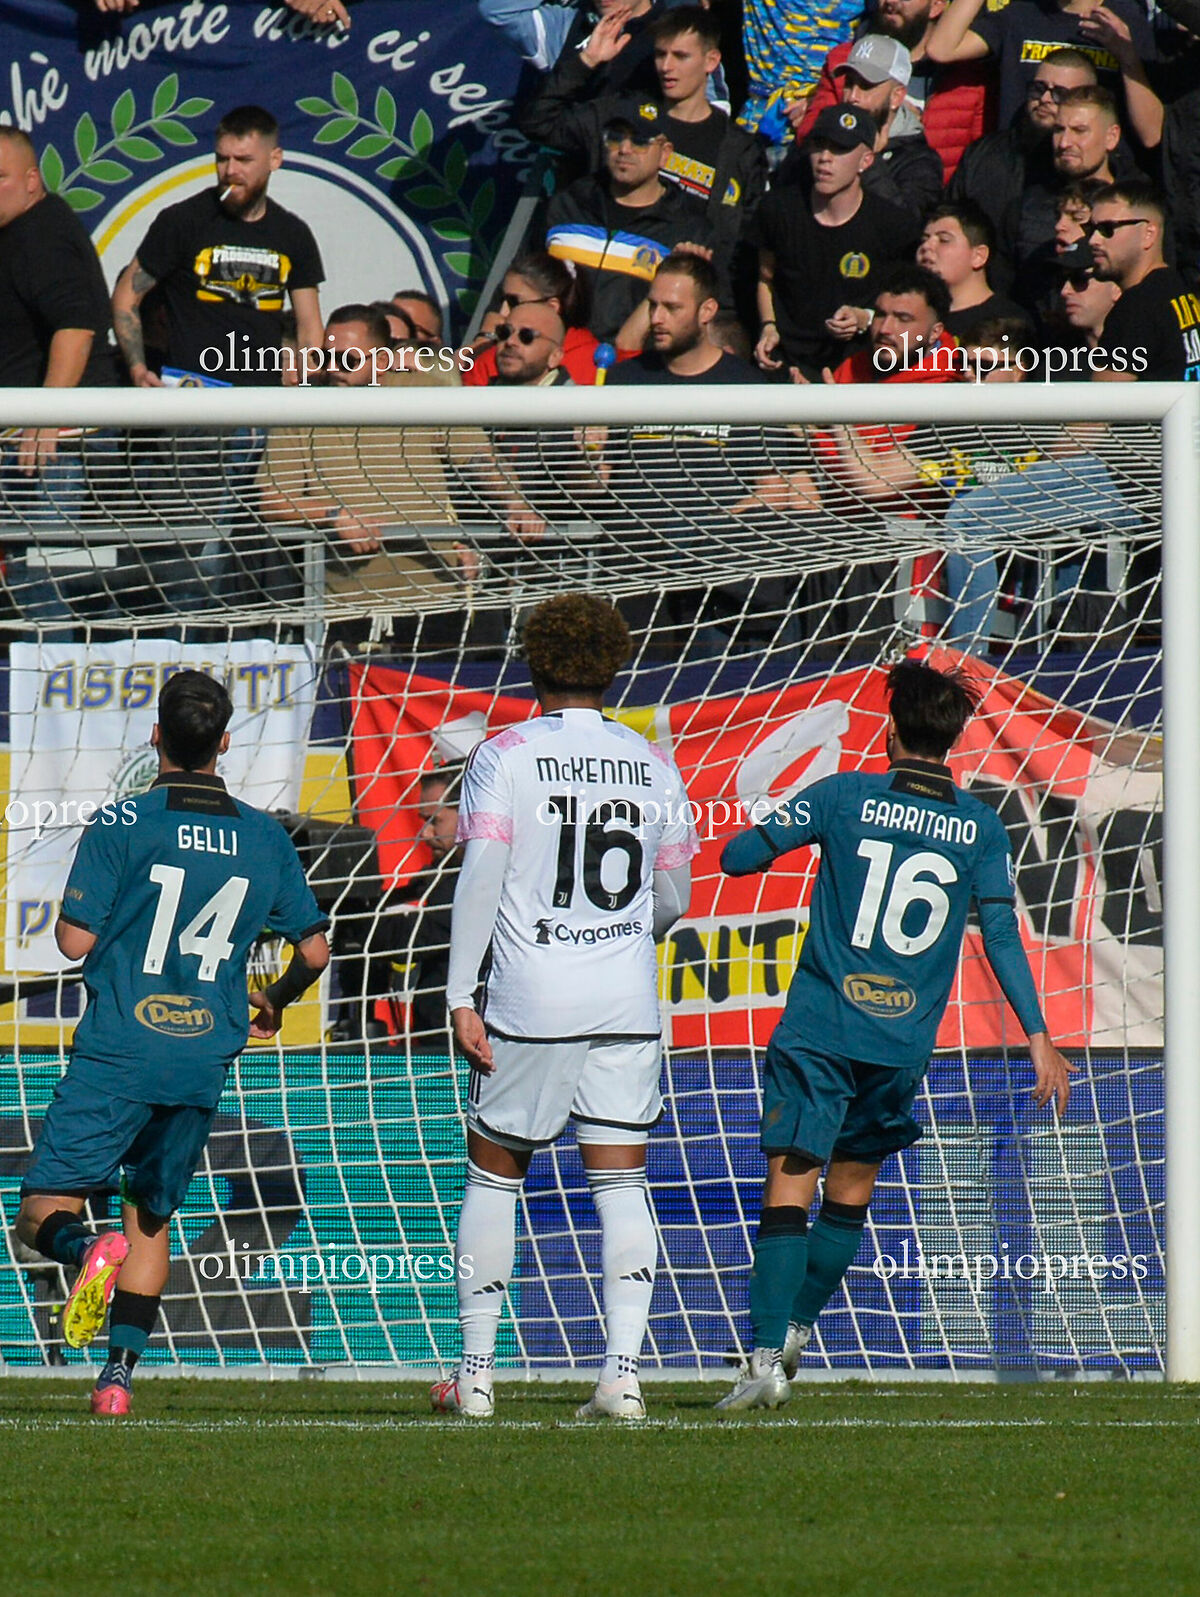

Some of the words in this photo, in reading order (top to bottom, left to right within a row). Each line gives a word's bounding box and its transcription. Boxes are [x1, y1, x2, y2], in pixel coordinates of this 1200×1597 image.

[85, 0, 230, 81] morte
[367, 30, 430, 71] ci
[43, 660, 295, 712] ASSTI
[536, 757, 652, 787] McKENNIE
[178, 824, 238, 856] GELLI
[860, 799, 978, 845] GARRITANO
[548, 796, 646, 912] 16
[851, 838, 958, 956] 16
[143, 864, 250, 982] 14
[554, 920, 643, 944] Cygames
[147, 1003, 210, 1025] Dem
[850, 981, 910, 1007] Dem
